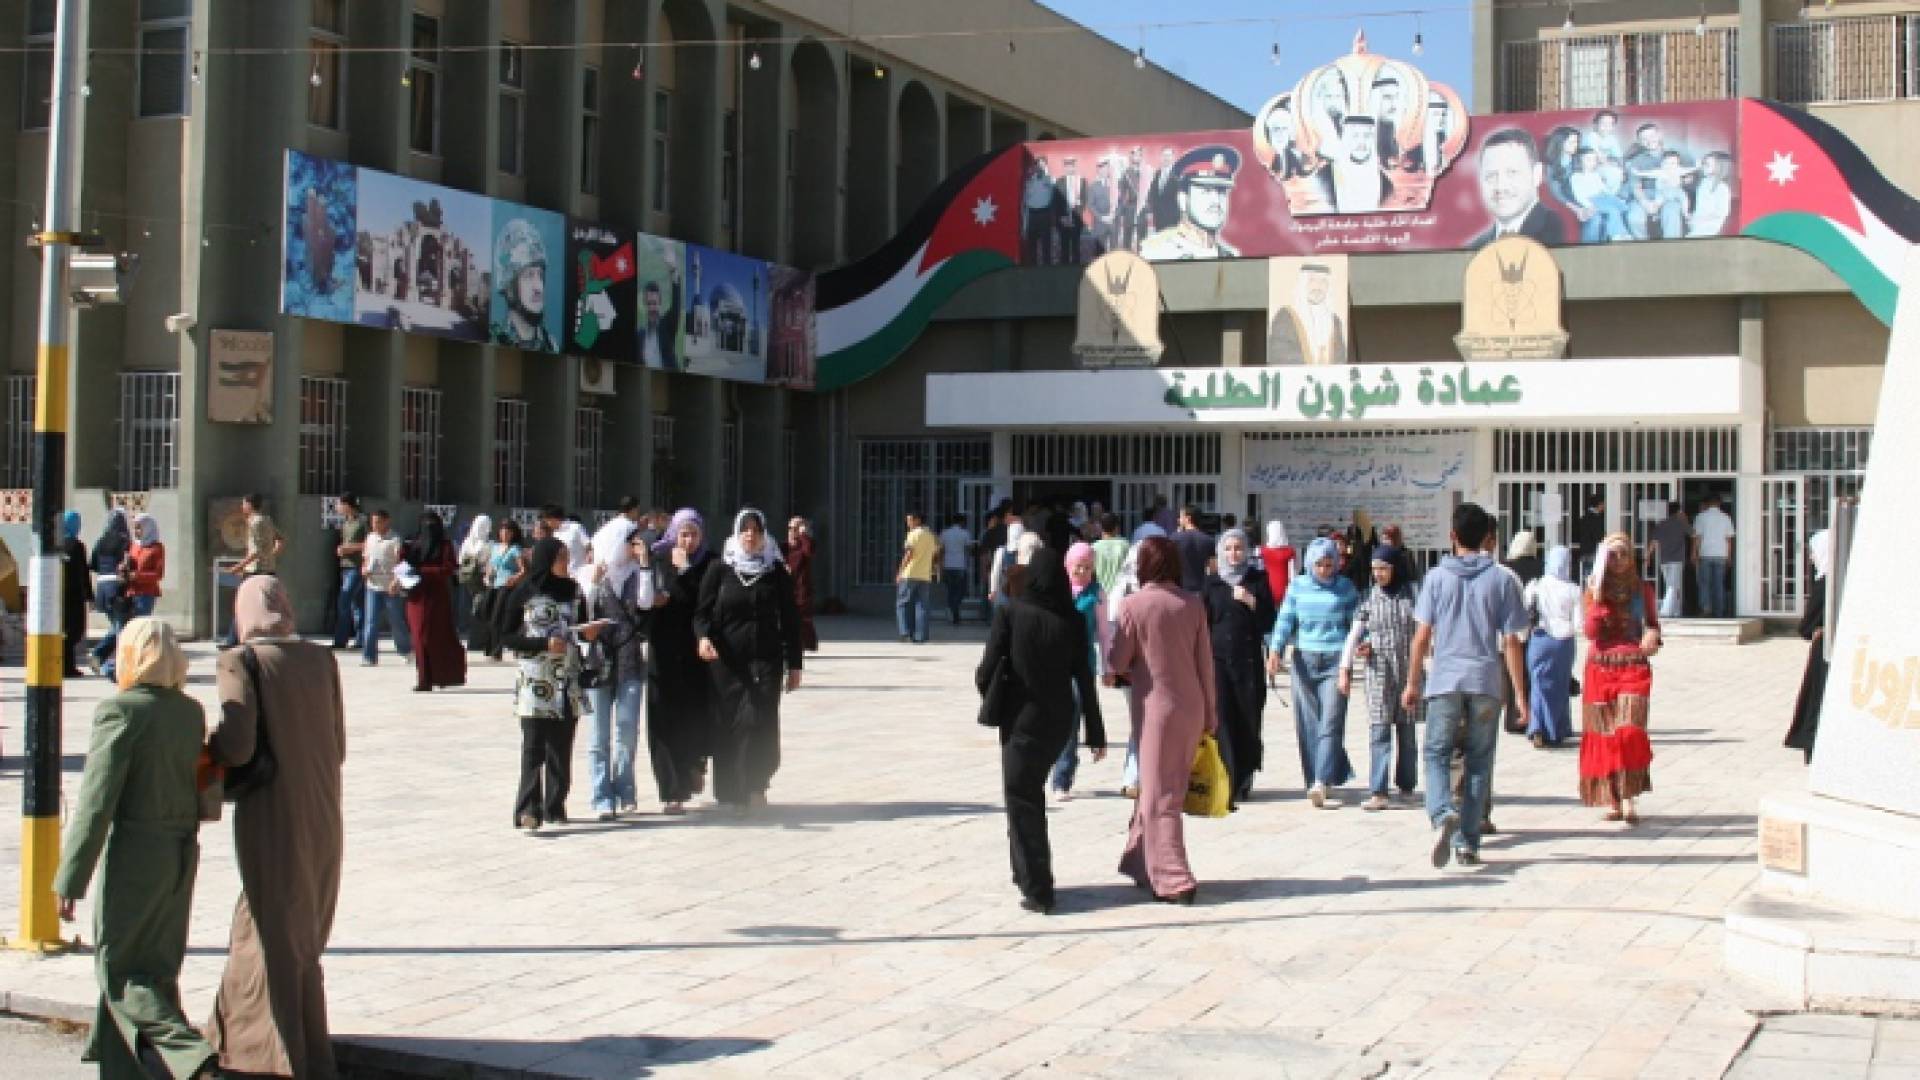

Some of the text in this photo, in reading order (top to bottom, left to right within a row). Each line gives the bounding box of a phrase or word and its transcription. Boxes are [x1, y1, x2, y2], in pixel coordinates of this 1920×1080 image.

[1327, 217, 1360, 231] جامعة
[1164, 366, 1522, 420] عمادة شؤون الطلبة
